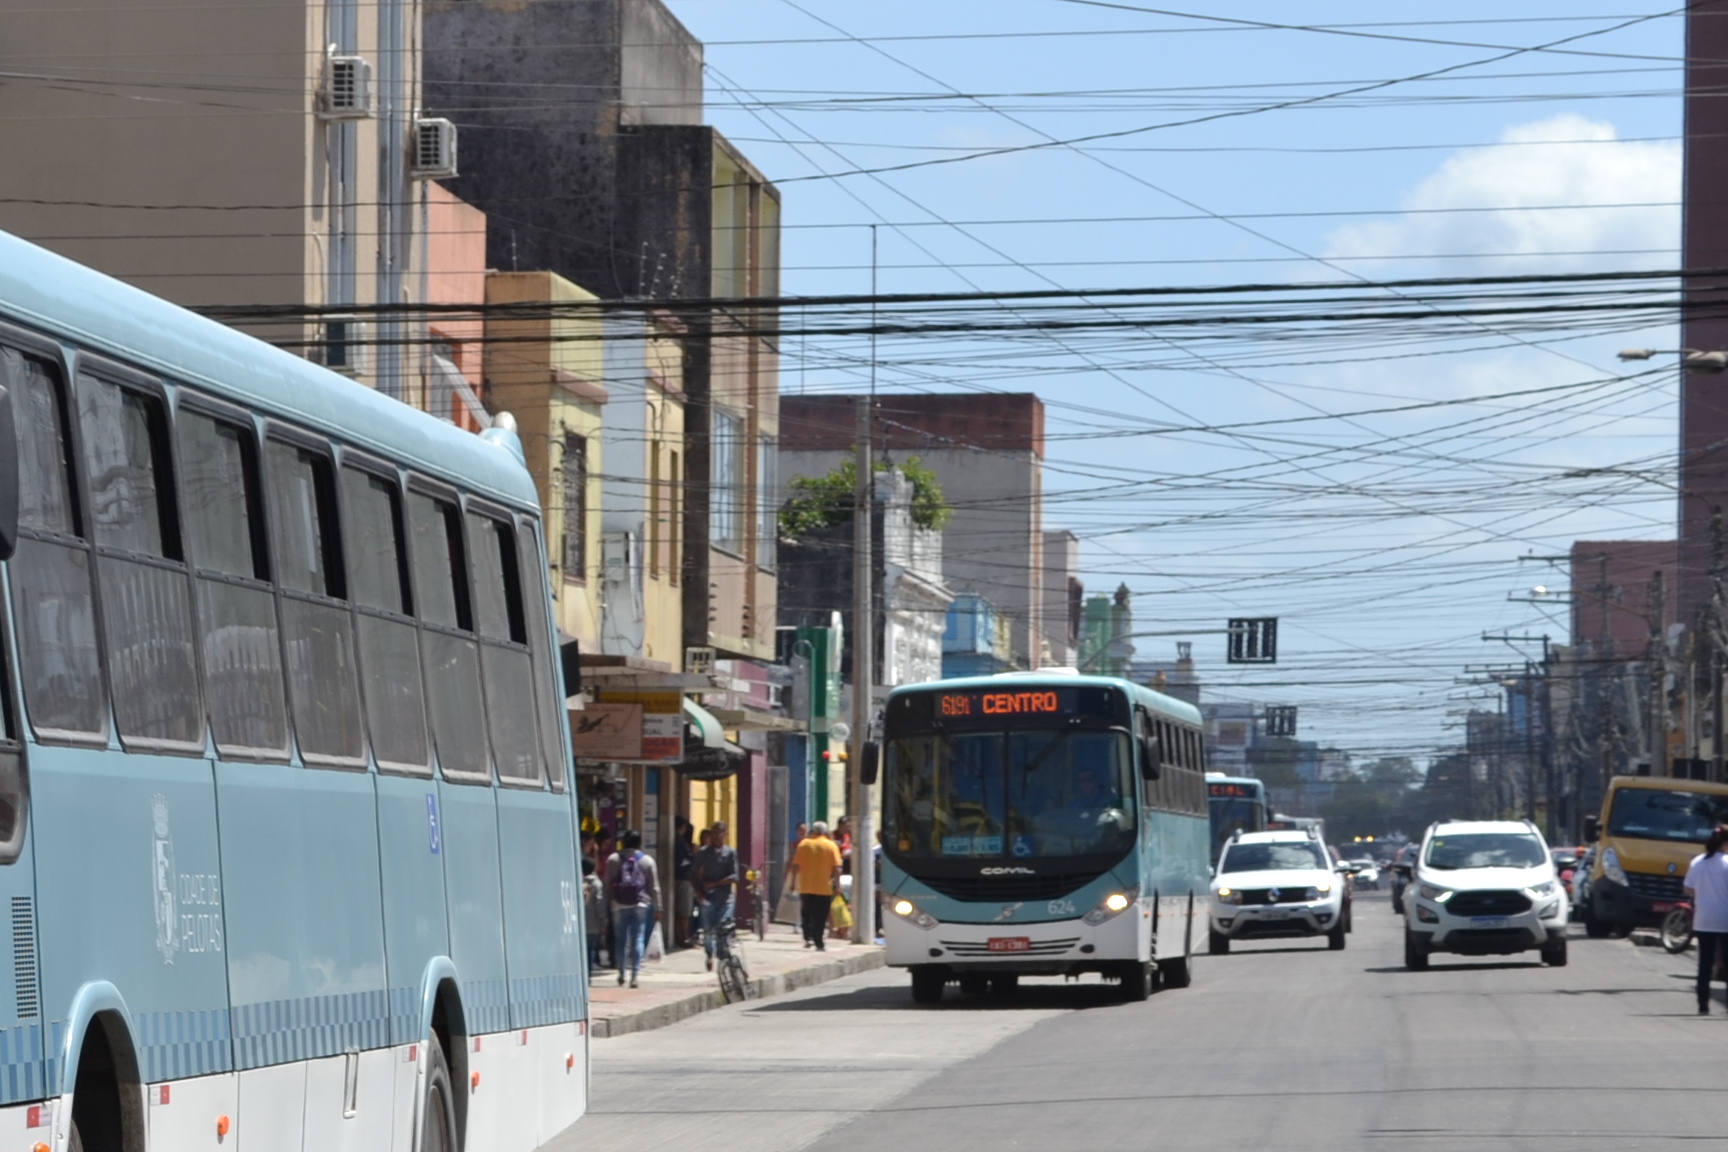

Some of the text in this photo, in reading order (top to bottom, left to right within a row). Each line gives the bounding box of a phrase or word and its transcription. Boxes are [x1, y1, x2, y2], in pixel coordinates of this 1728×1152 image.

[982, 691, 1058, 714] CENTRO
[980, 866, 1035, 876] COMIL
[1047, 900, 1075, 914] 624
[181, 913, 221, 953] PELOTAS
